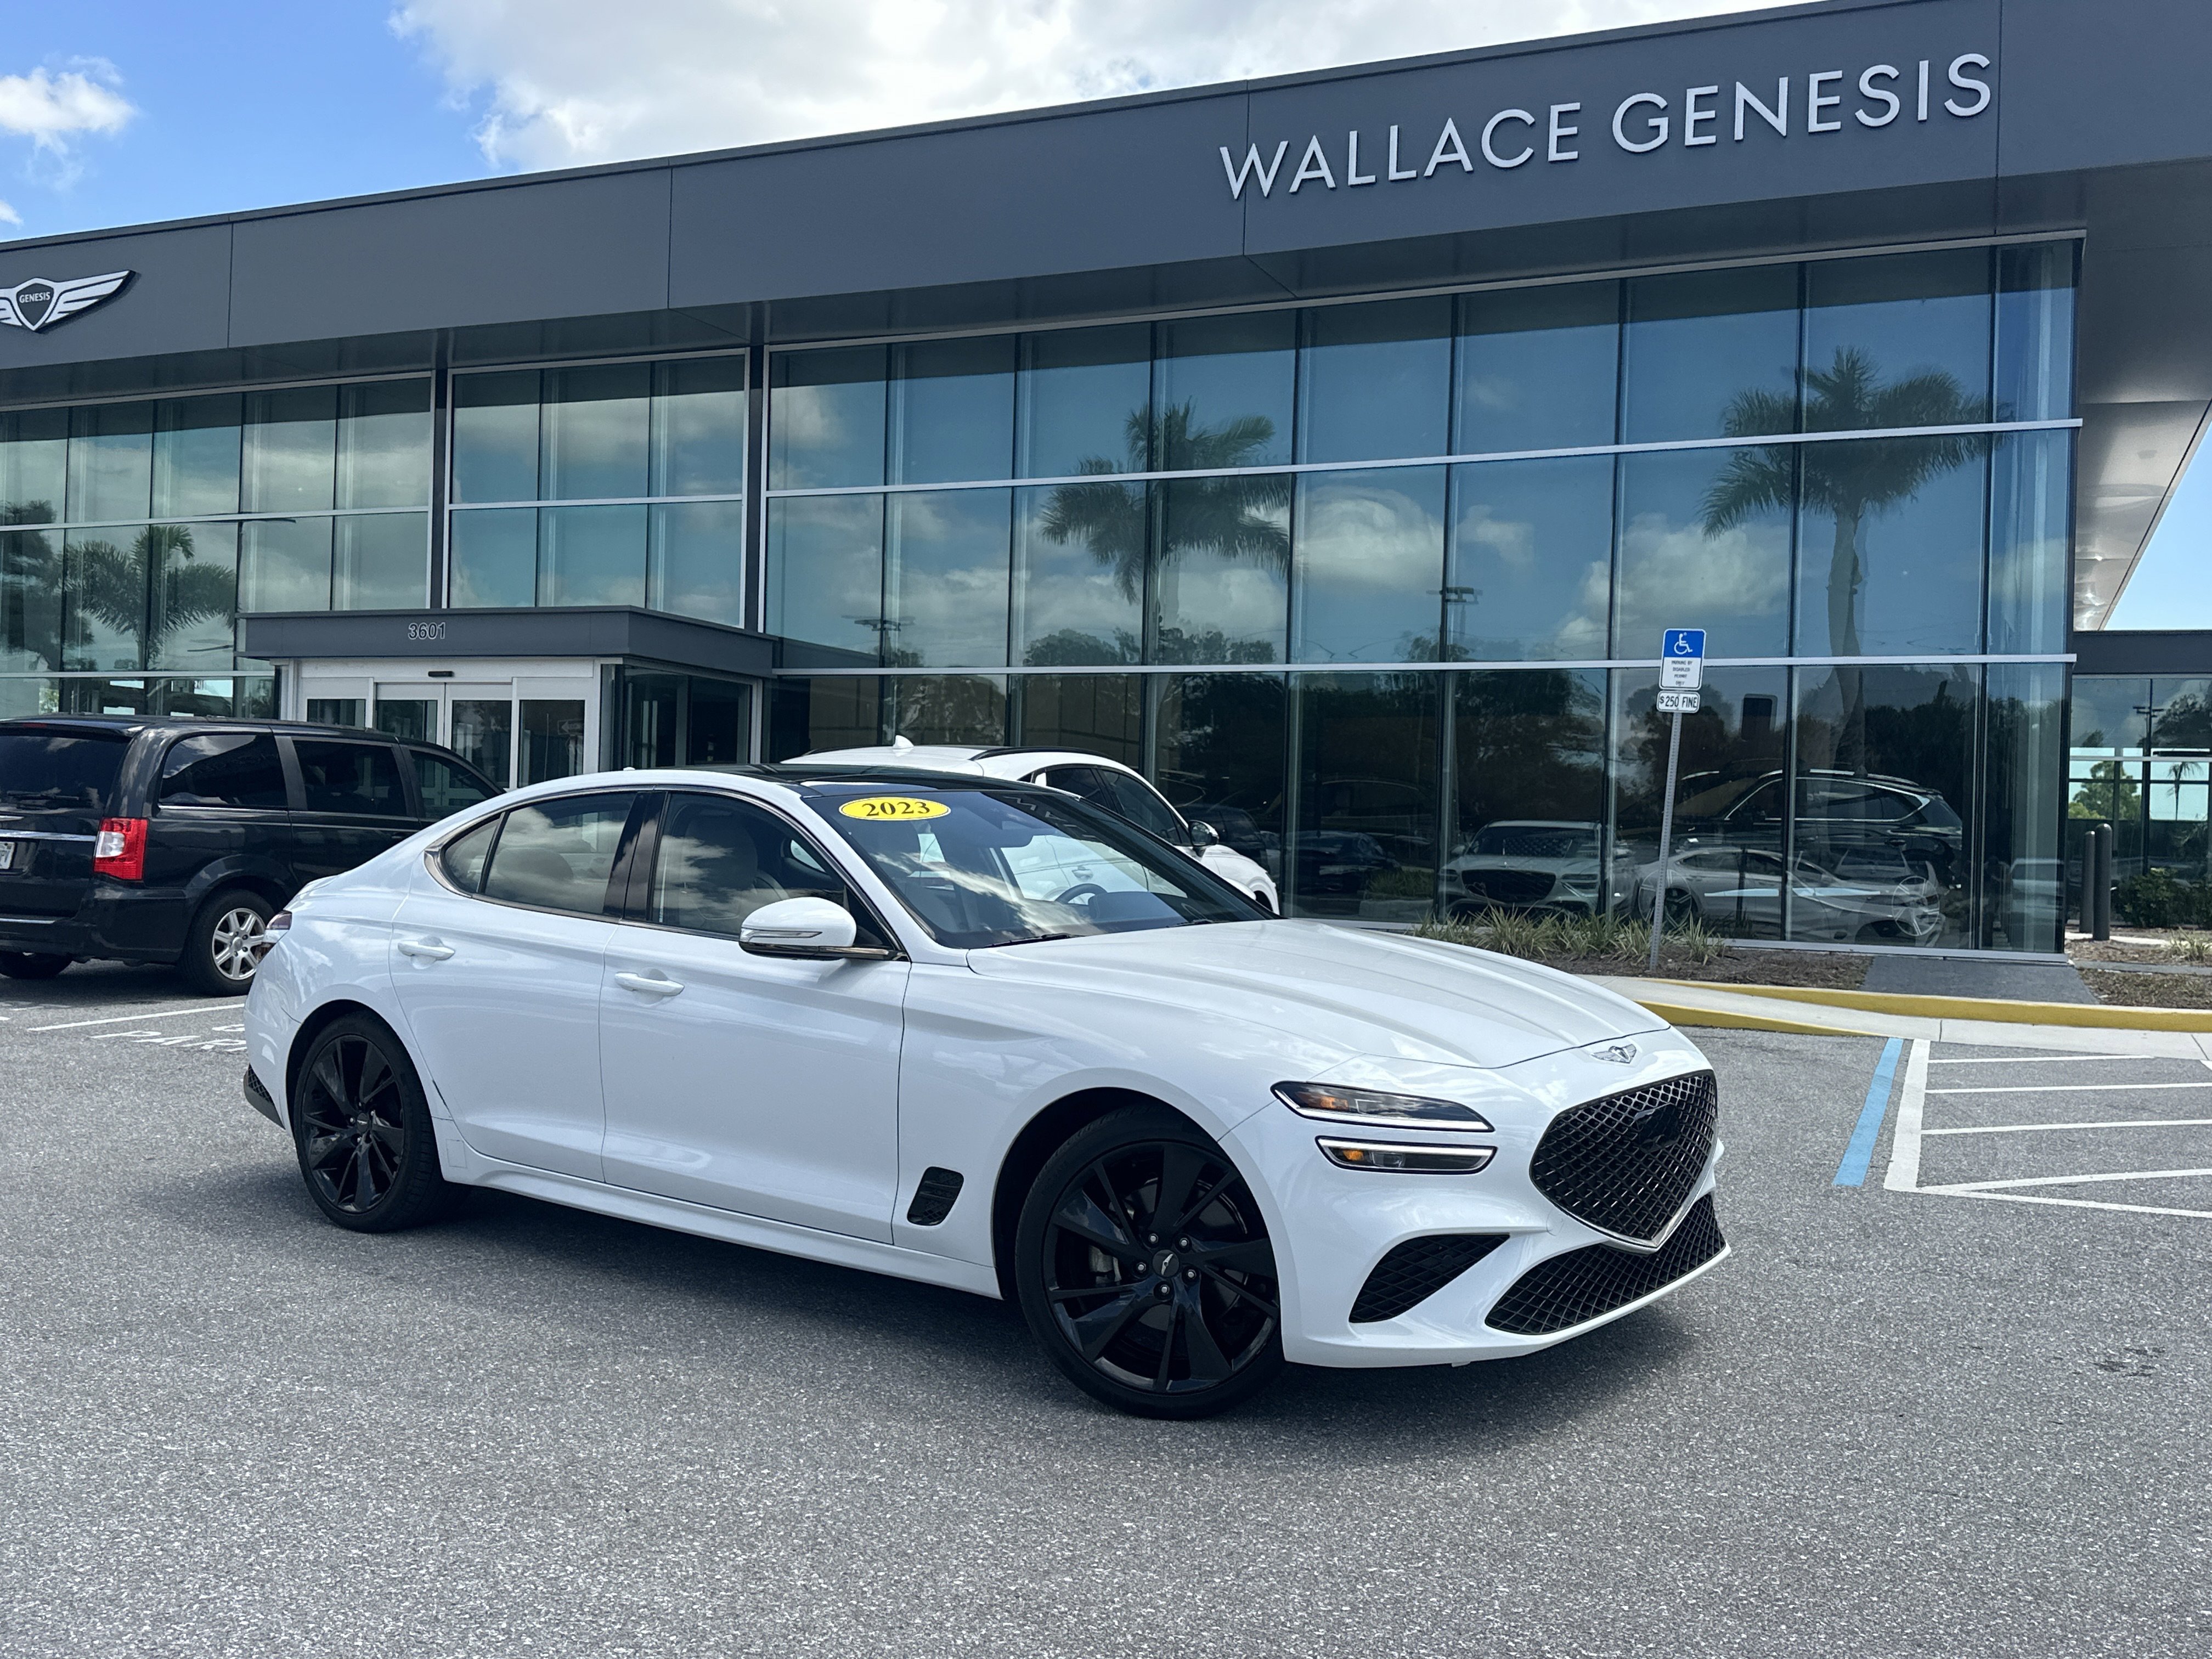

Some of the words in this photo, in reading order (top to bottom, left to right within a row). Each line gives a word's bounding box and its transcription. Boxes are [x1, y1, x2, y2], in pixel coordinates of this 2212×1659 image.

[1219, 101, 1581, 200] WALLACE
[1612, 53, 1991, 153] GENESIS
[20, 292, 51, 303] GENESIS
[408, 622, 445, 640] 3601
[1660, 696, 1680, 707] $250
[1681, 697, 1697, 708] FINE
[862, 802, 930, 816] 2023
